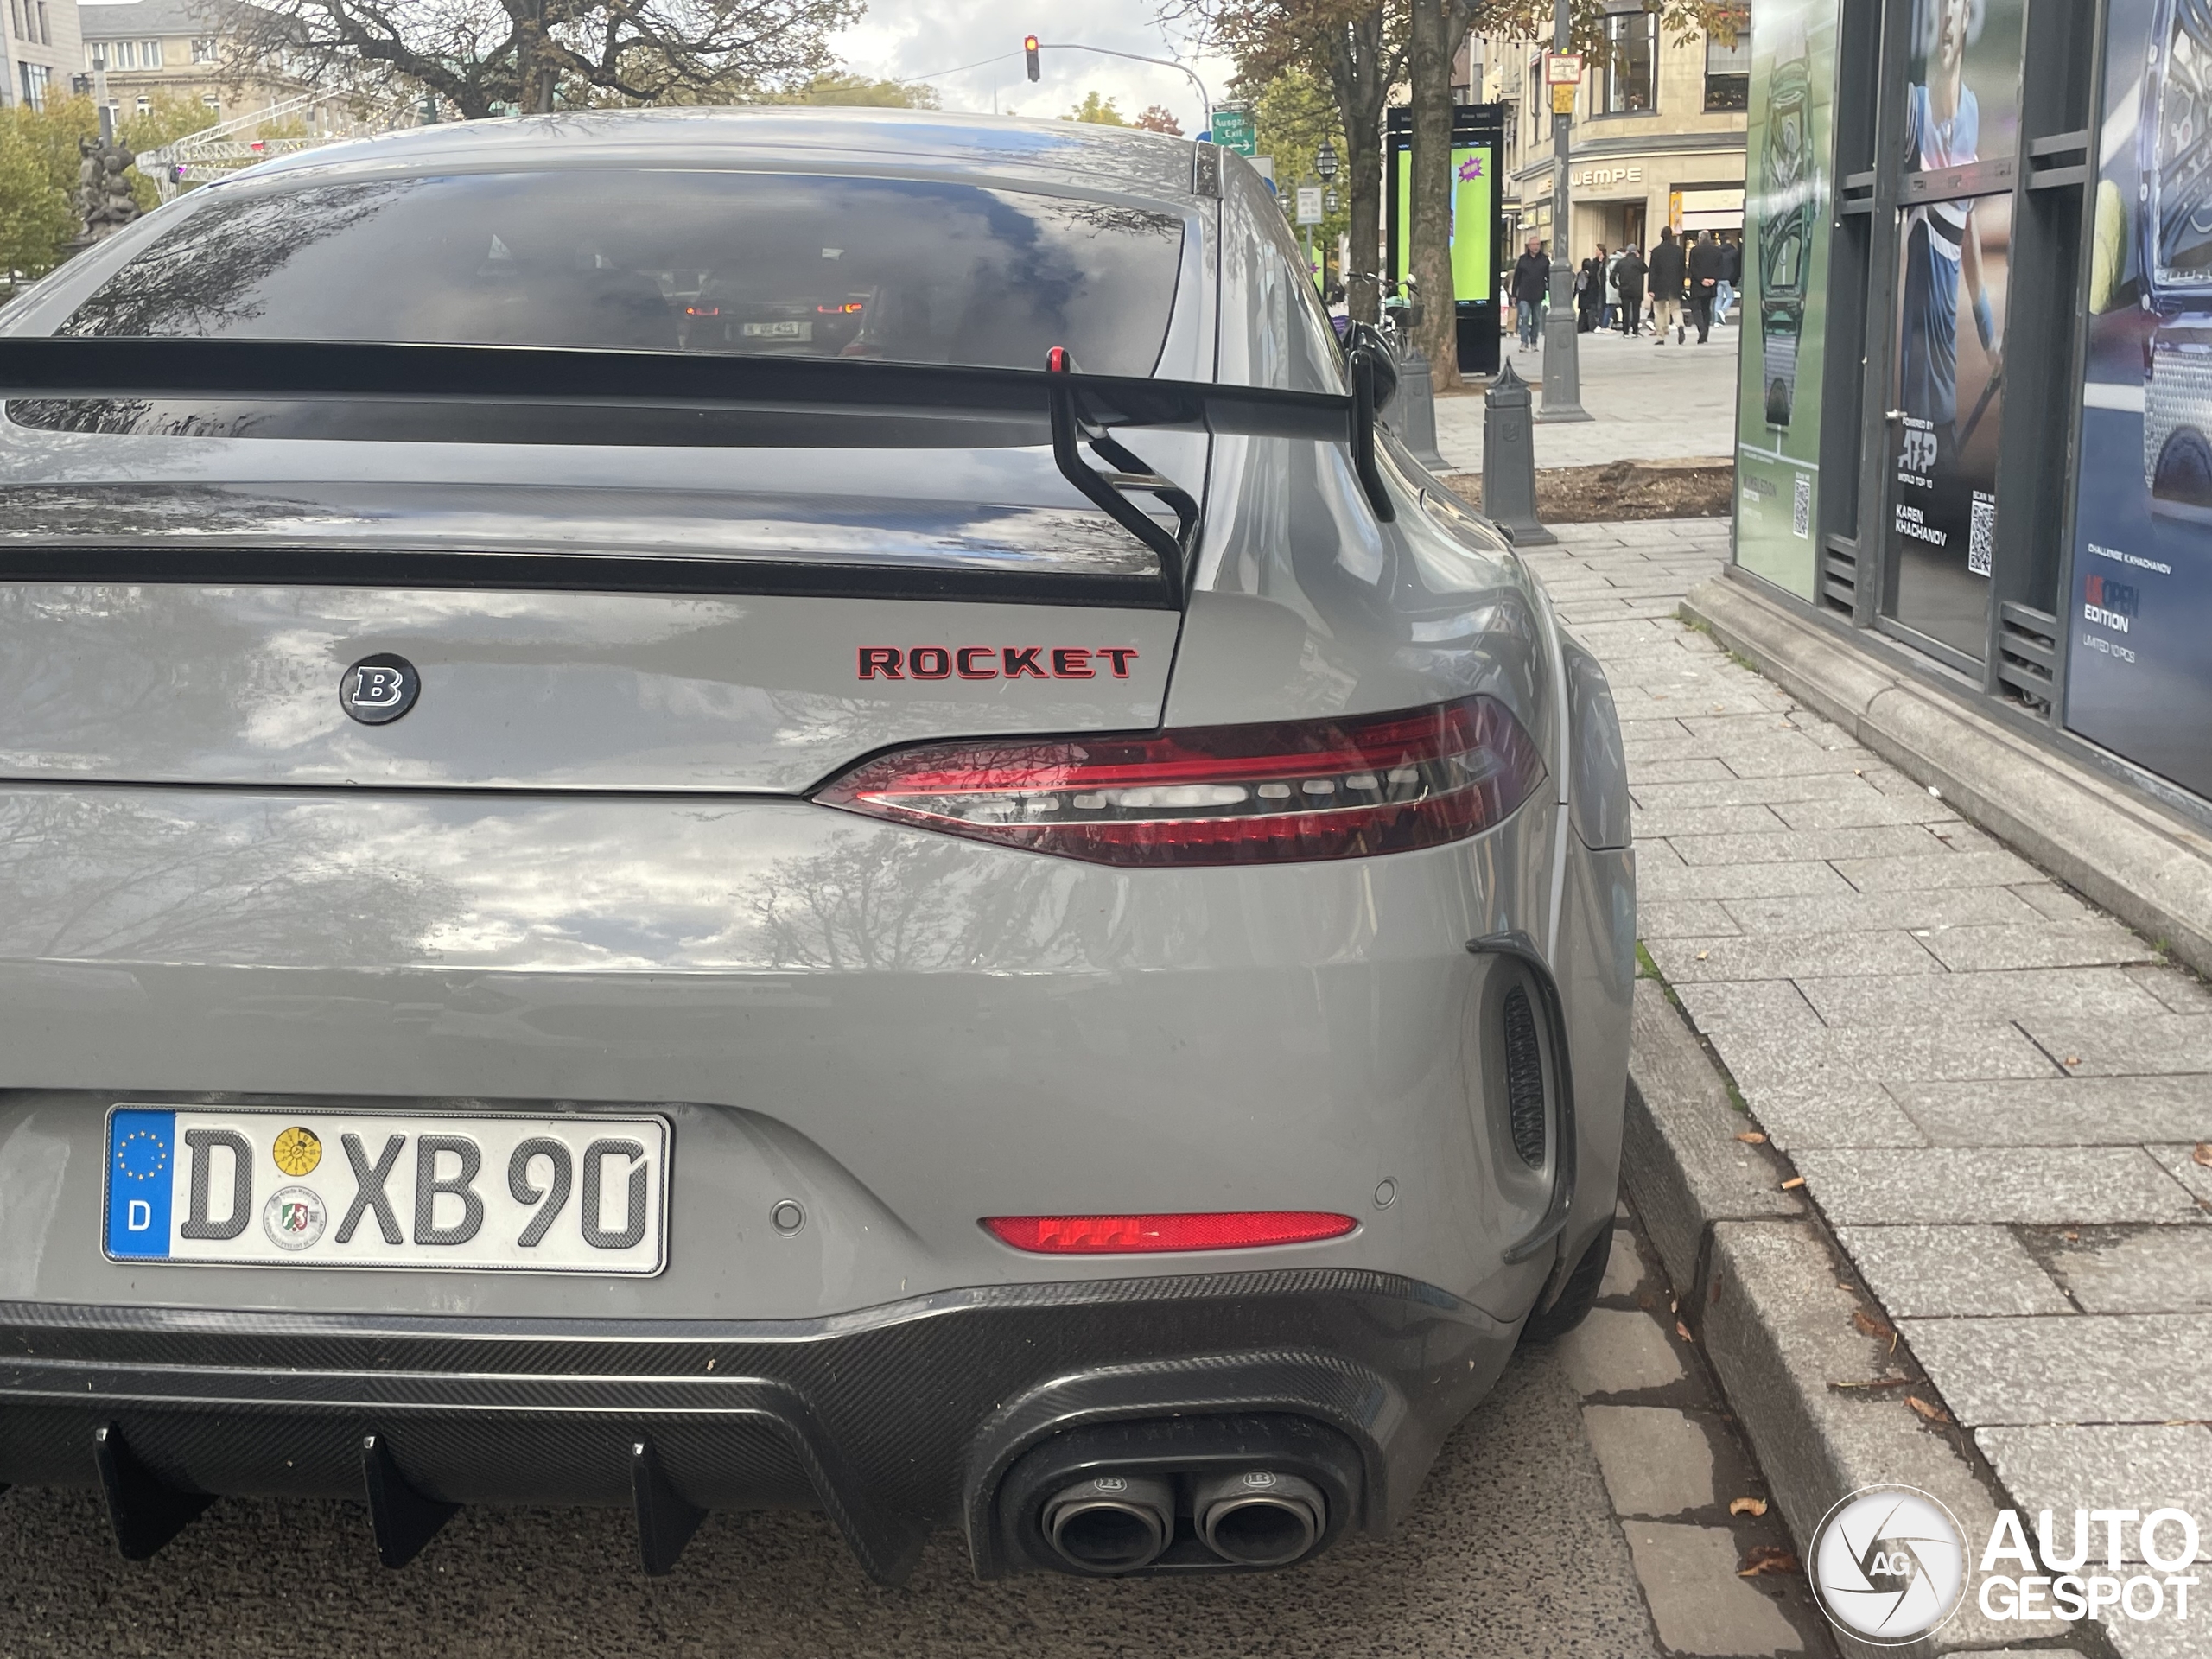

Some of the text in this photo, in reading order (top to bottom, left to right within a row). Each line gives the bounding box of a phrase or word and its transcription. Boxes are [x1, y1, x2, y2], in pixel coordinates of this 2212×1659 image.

[1224, 129, 1243, 138] Exit
[1570, 167, 1642, 186] WEMPE
[1903, 416, 1934, 430] POWERED BY
[1897, 429, 1938, 474] ATP
[1897, 473, 1933, 489] WORLD TOP 10
[1972, 489, 1987, 502] SCAN
[1896, 503, 1924, 524] KAREN
[1895, 518, 1948, 547] KHACHANOV
[2088, 543, 2123, 562] CHALLENGE
[2084, 603, 2129, 633] EDITION
[2083, 633, 2109, 653] LIMITED
[858, 647, 1139, 680] ROCKET
[180, 1128, 648, 1249] D XB 90
[128, 1200, 152, 1231] D
